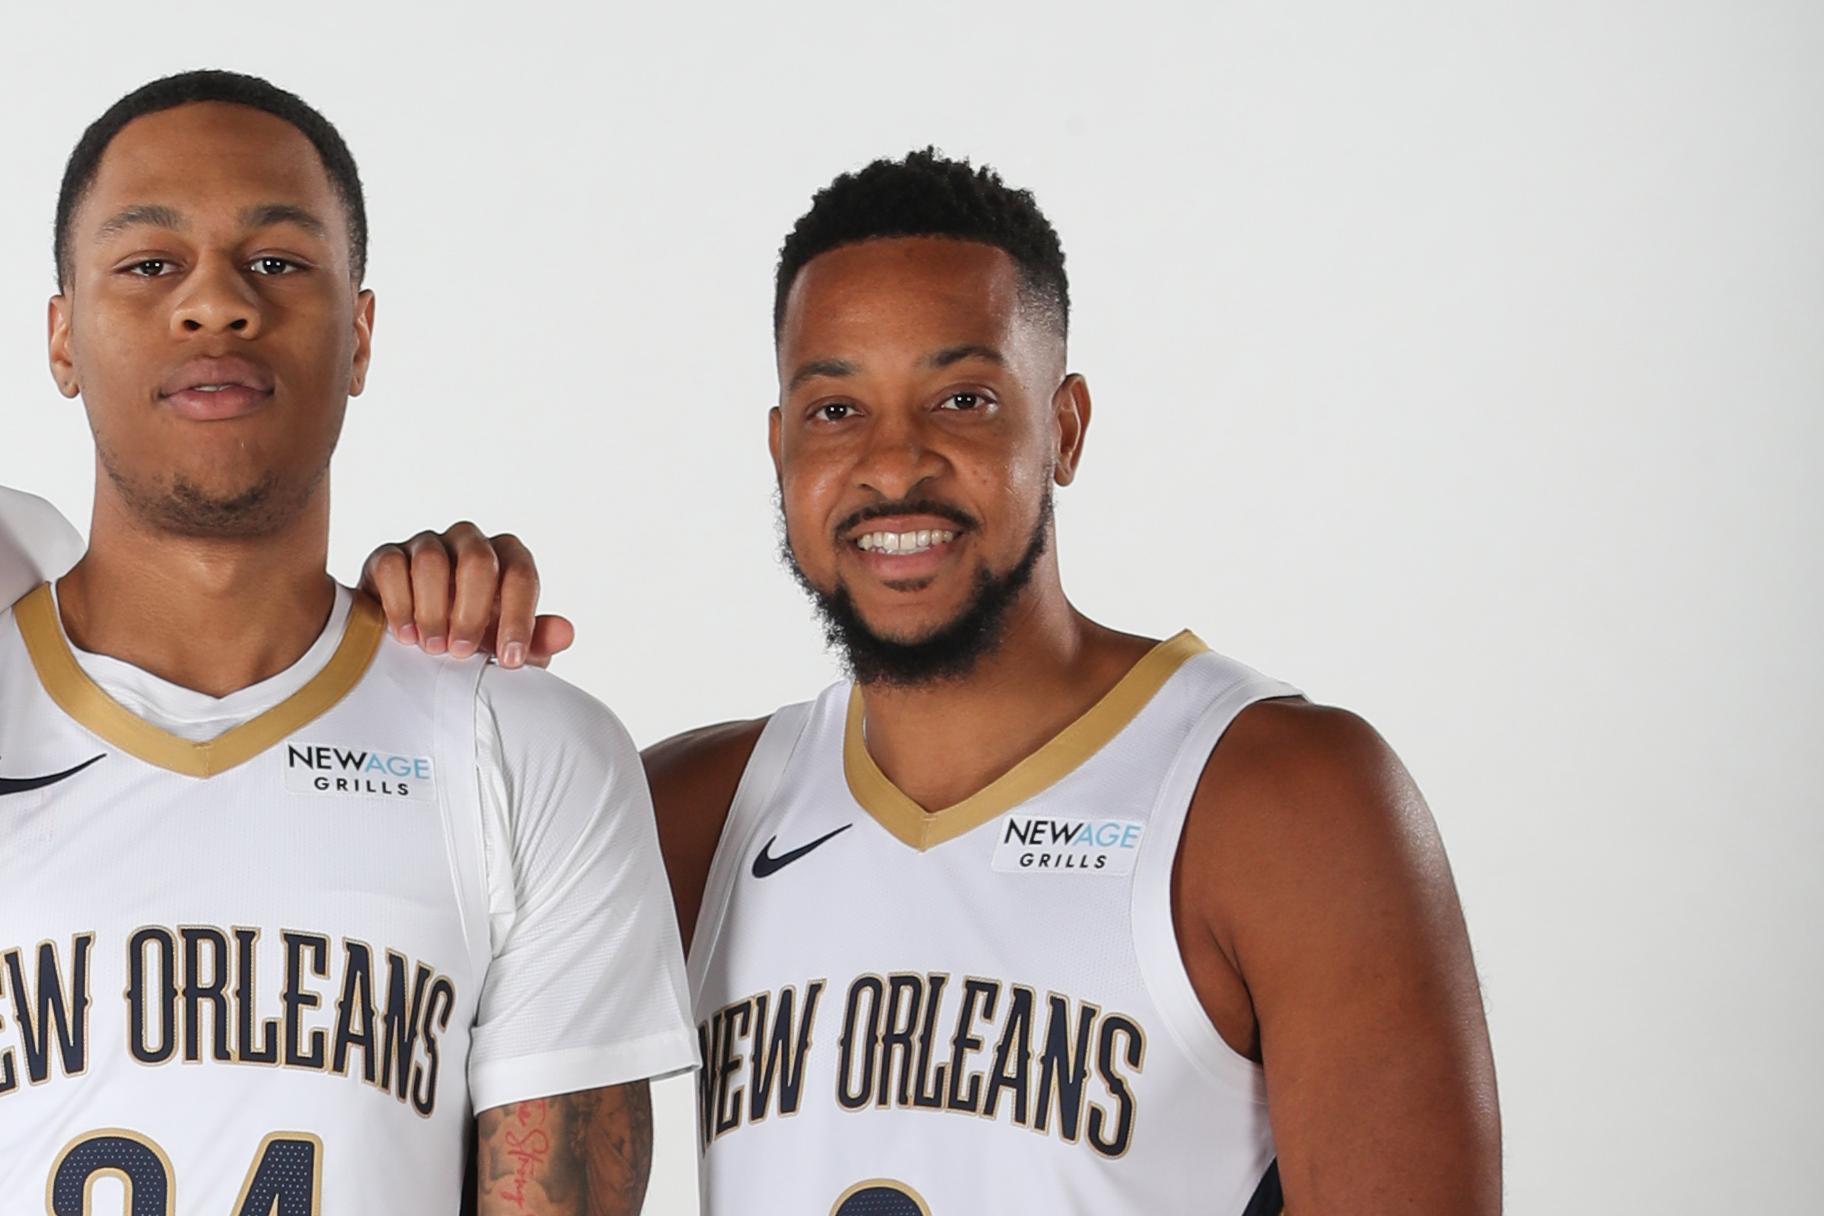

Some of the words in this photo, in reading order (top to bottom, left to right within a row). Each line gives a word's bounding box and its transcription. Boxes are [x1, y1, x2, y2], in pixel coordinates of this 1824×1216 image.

[313, 776, 410, 797] GRILLS
[1019, 852, 1108, 870] GRILLS
[124, 923, 457, 1120] ORLEANS
[698, 977, 827, 1160] NEW
[835, 969, 1148, 1162] ORLEANS
